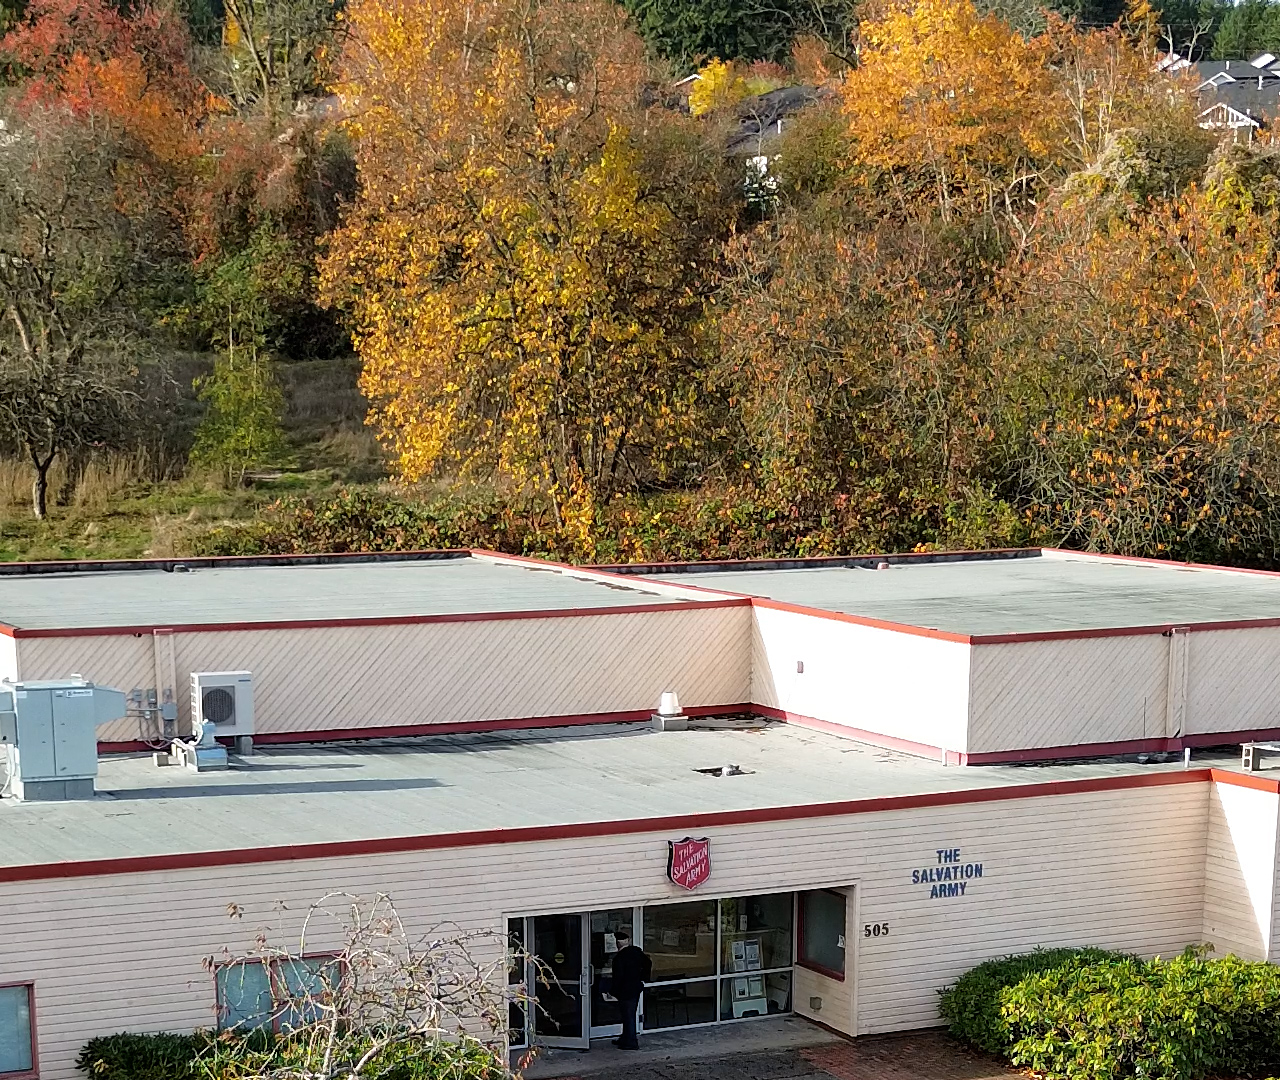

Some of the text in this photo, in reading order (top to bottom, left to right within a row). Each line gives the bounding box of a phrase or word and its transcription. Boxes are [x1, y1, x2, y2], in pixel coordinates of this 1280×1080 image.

[679, 843, 694, 861] THE
[936, 849, 961, 864] THE
[674, 844, 707, 879] SALVATION
[686, 859, 706, 886] ARMY
[912, 864, 983, 884] SALVATION
[930, 882, 967, 899] ARMY
[864, 923, 889, 937] 505
